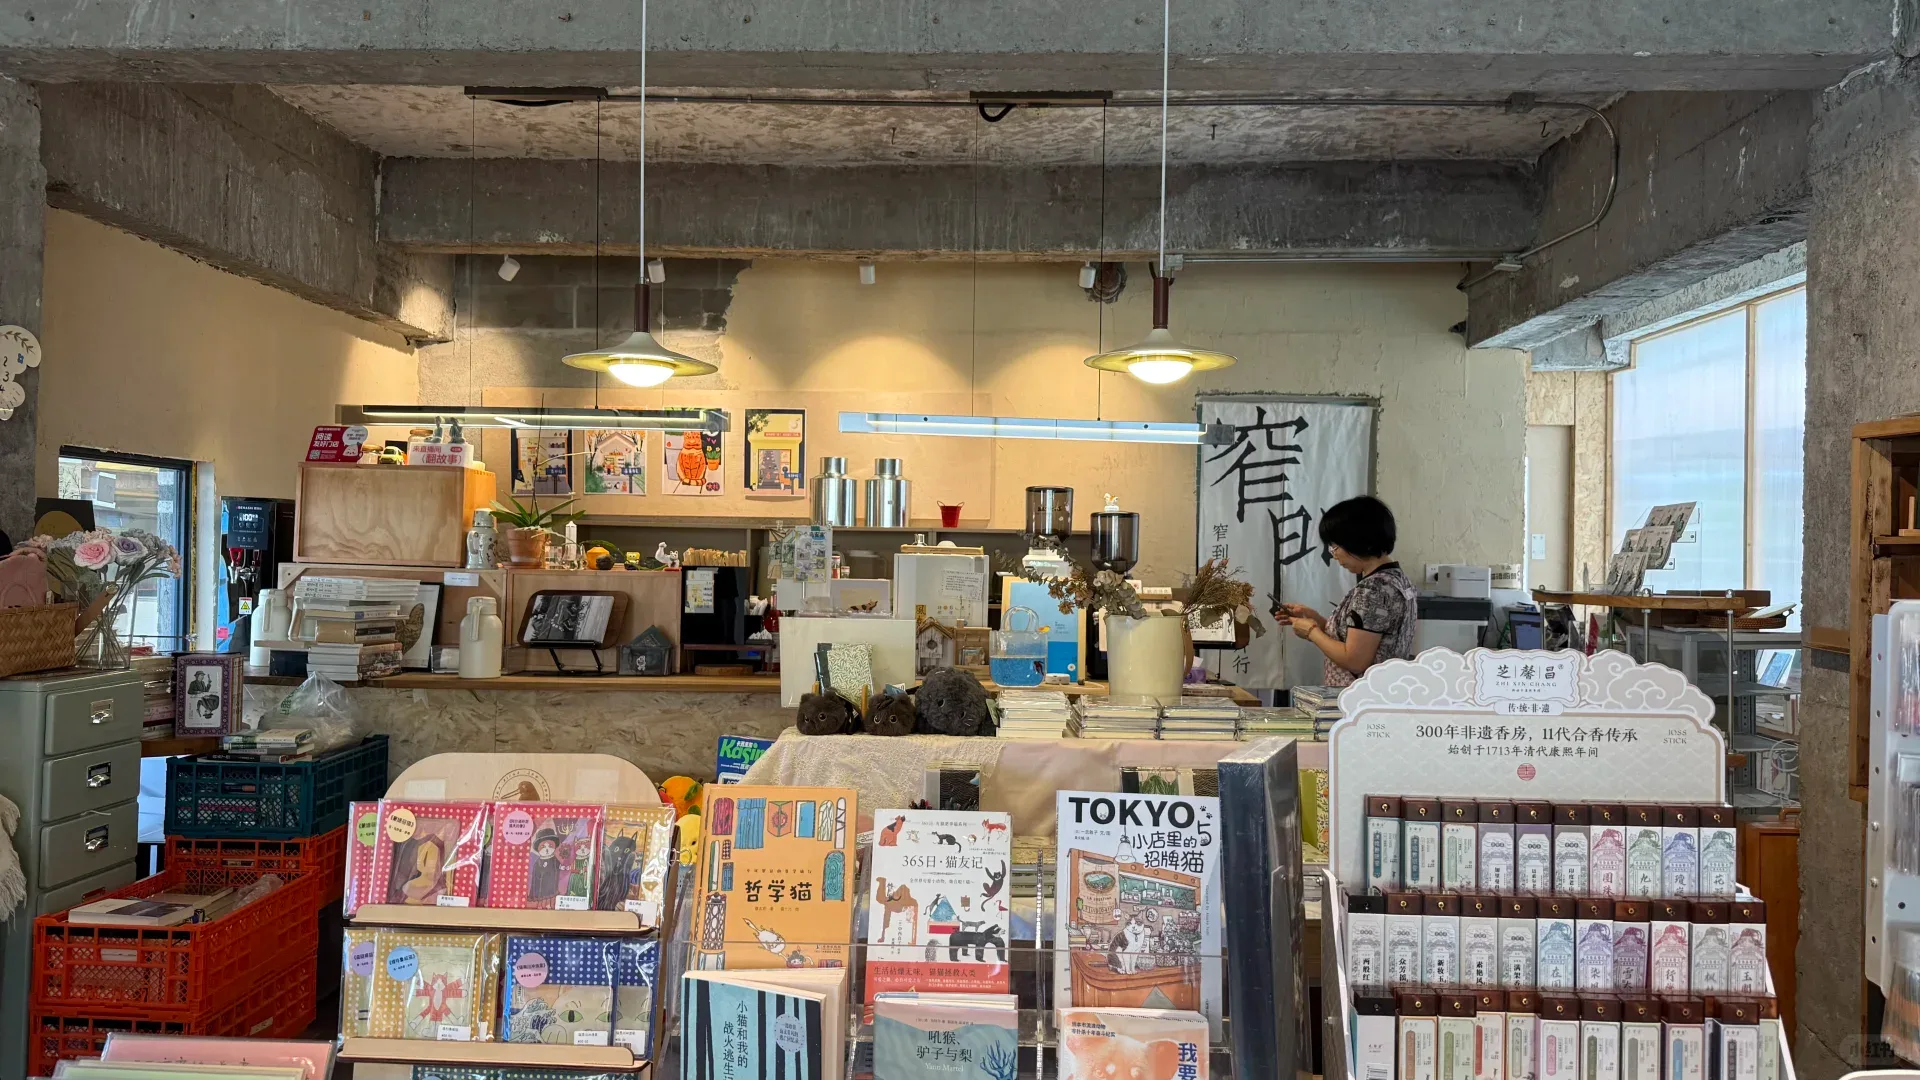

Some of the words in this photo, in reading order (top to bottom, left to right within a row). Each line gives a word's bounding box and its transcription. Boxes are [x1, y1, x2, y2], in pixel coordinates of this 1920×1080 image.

[412, 445, 442, 453] 来直播间
[1447, 744, 1599, 758] 始创于1713年清代康熙年间
[1068, 797, 1195, 829] TOKYO
[1132, 831, 1197, 850] 小店里的
[1197, 820, 1212, 846] 5
[902, 855, 983, 869] 365日·猫友记
[1143, 849, 1205, 873] 招牌猫
[745, 879, 812, 902] 哲学猫
[736, 1000, 749, 1069] 小猫和我的
[916, 1045, 973, 1063] 驴子与梨
[925, 1062, 941, 1070] Yann
[942, 1063, 964, 1072] Martel
